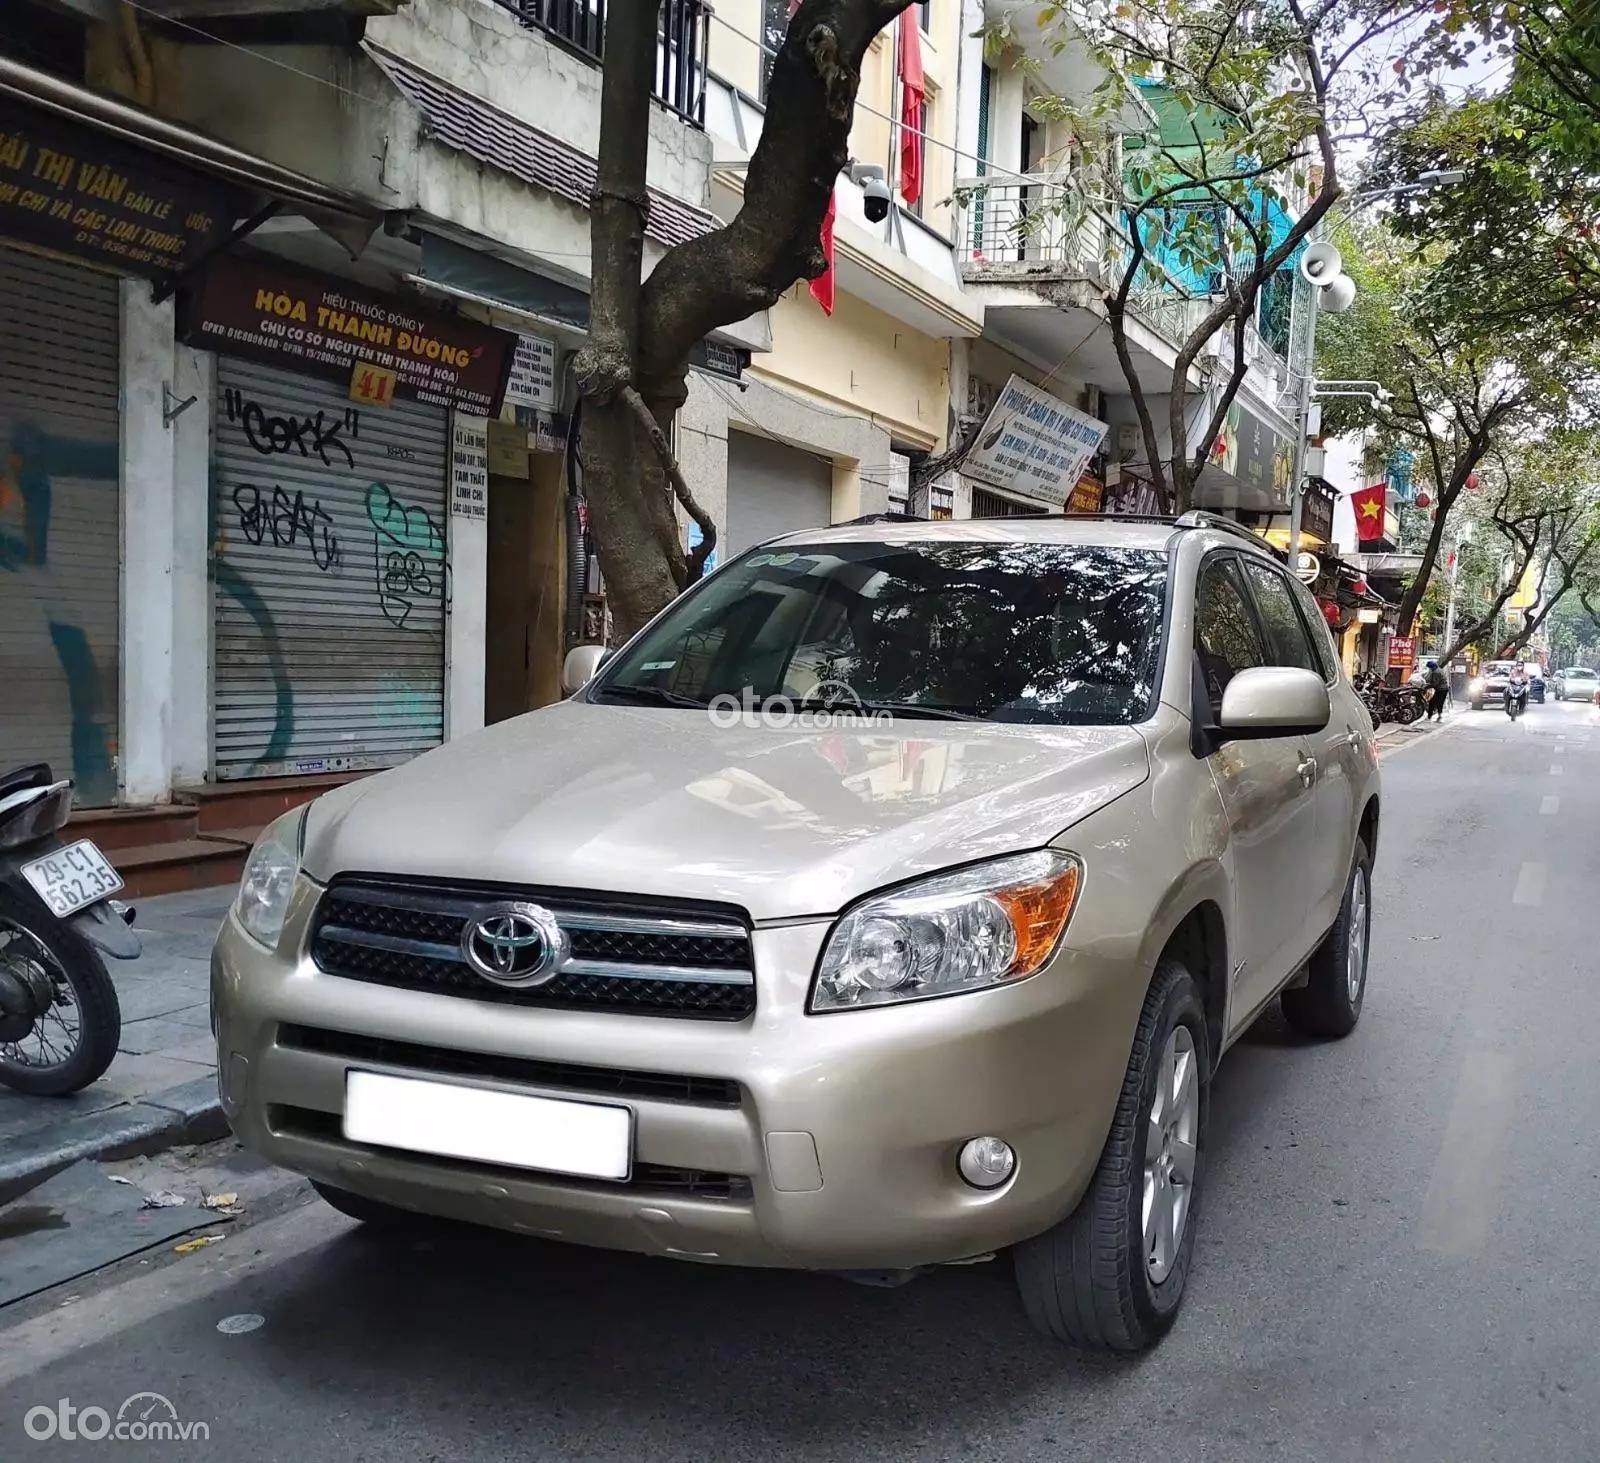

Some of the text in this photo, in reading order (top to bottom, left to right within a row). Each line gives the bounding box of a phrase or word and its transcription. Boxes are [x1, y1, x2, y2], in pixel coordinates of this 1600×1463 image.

[33, 147, 75, 190] THỊ
[77, 165, 129, 204] VÂN
[255, 288, 307, 322] HÒA
[316, 306, 391, 347] THANH
[322, 291, 425, 333] HIỆU THUỐC ĐÔNG Y
[358, 368, 388, 403] 41
[393, 356, 432, 379] THANH
[454, 470, 469, 483] TAM
[456, 486, 483, 501] LINH CHI
[46, 866, 117, 911] 562.35
